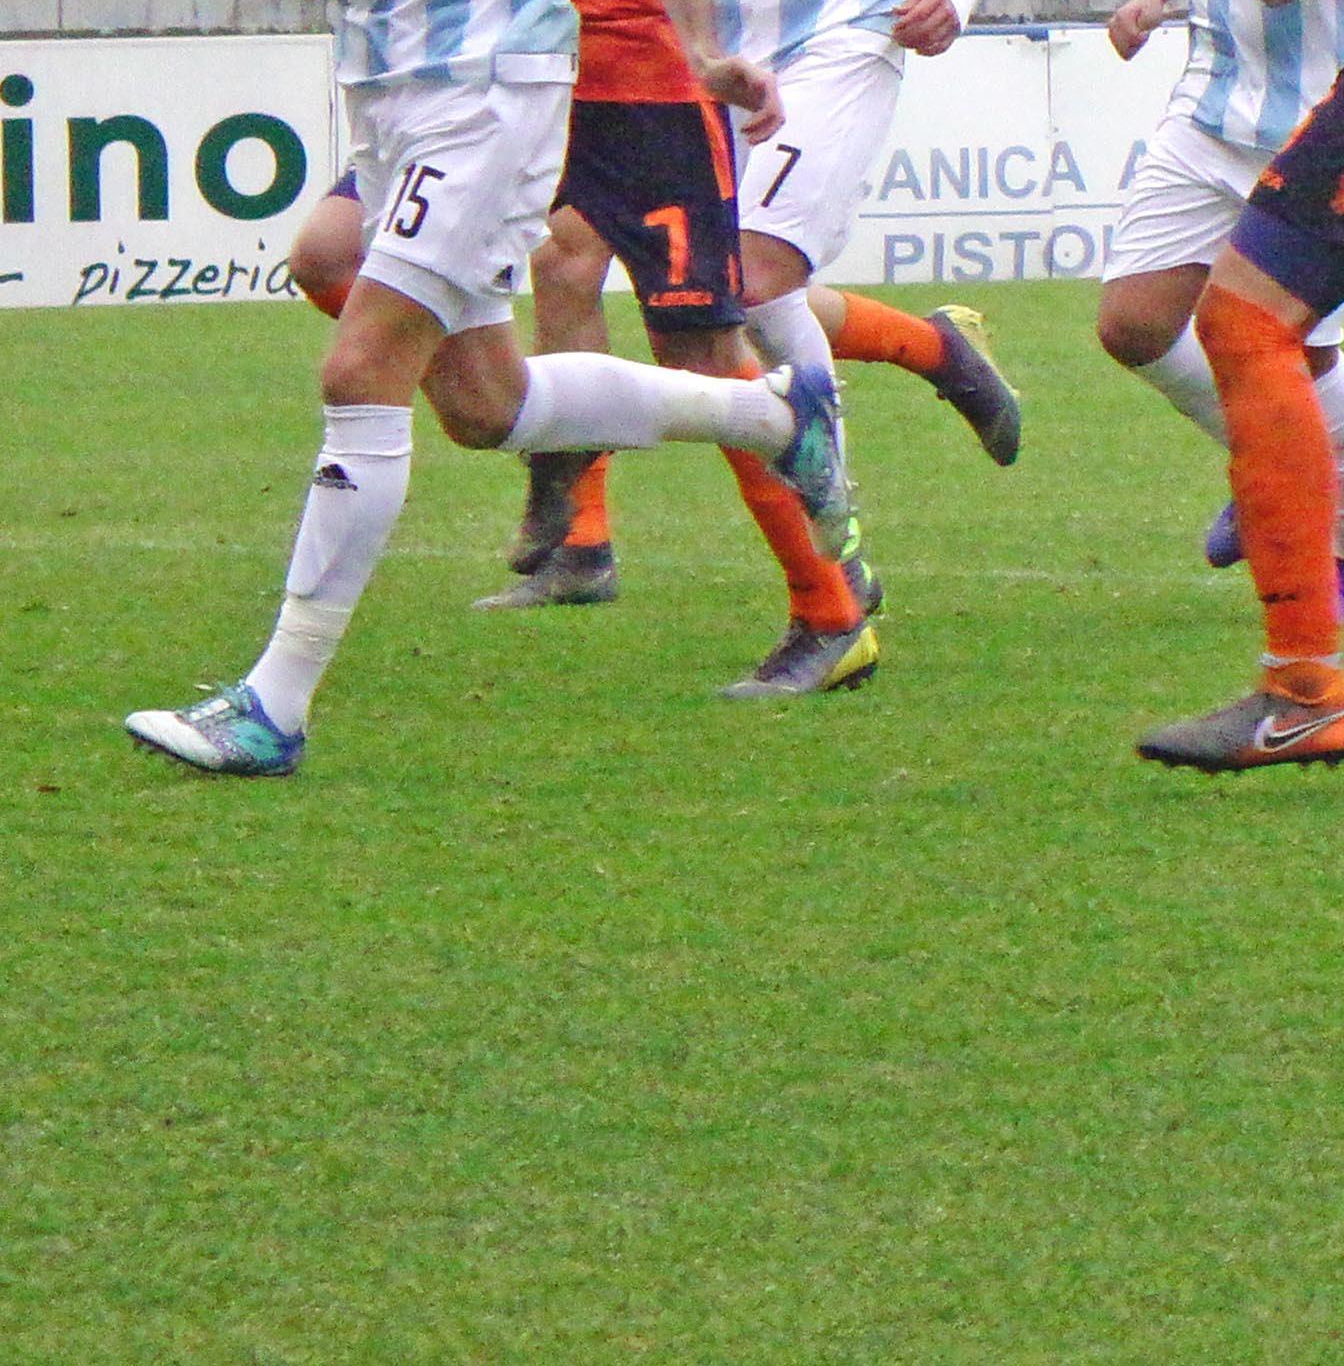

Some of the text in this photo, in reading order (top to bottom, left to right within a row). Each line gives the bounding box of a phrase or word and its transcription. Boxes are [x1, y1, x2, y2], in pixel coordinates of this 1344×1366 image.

[0, 74, 308, 223] ino
[761, 143, 801, 208] 7
[383, 162, 445, 240] 15
[72, 240, 302, 304] pizzeria
